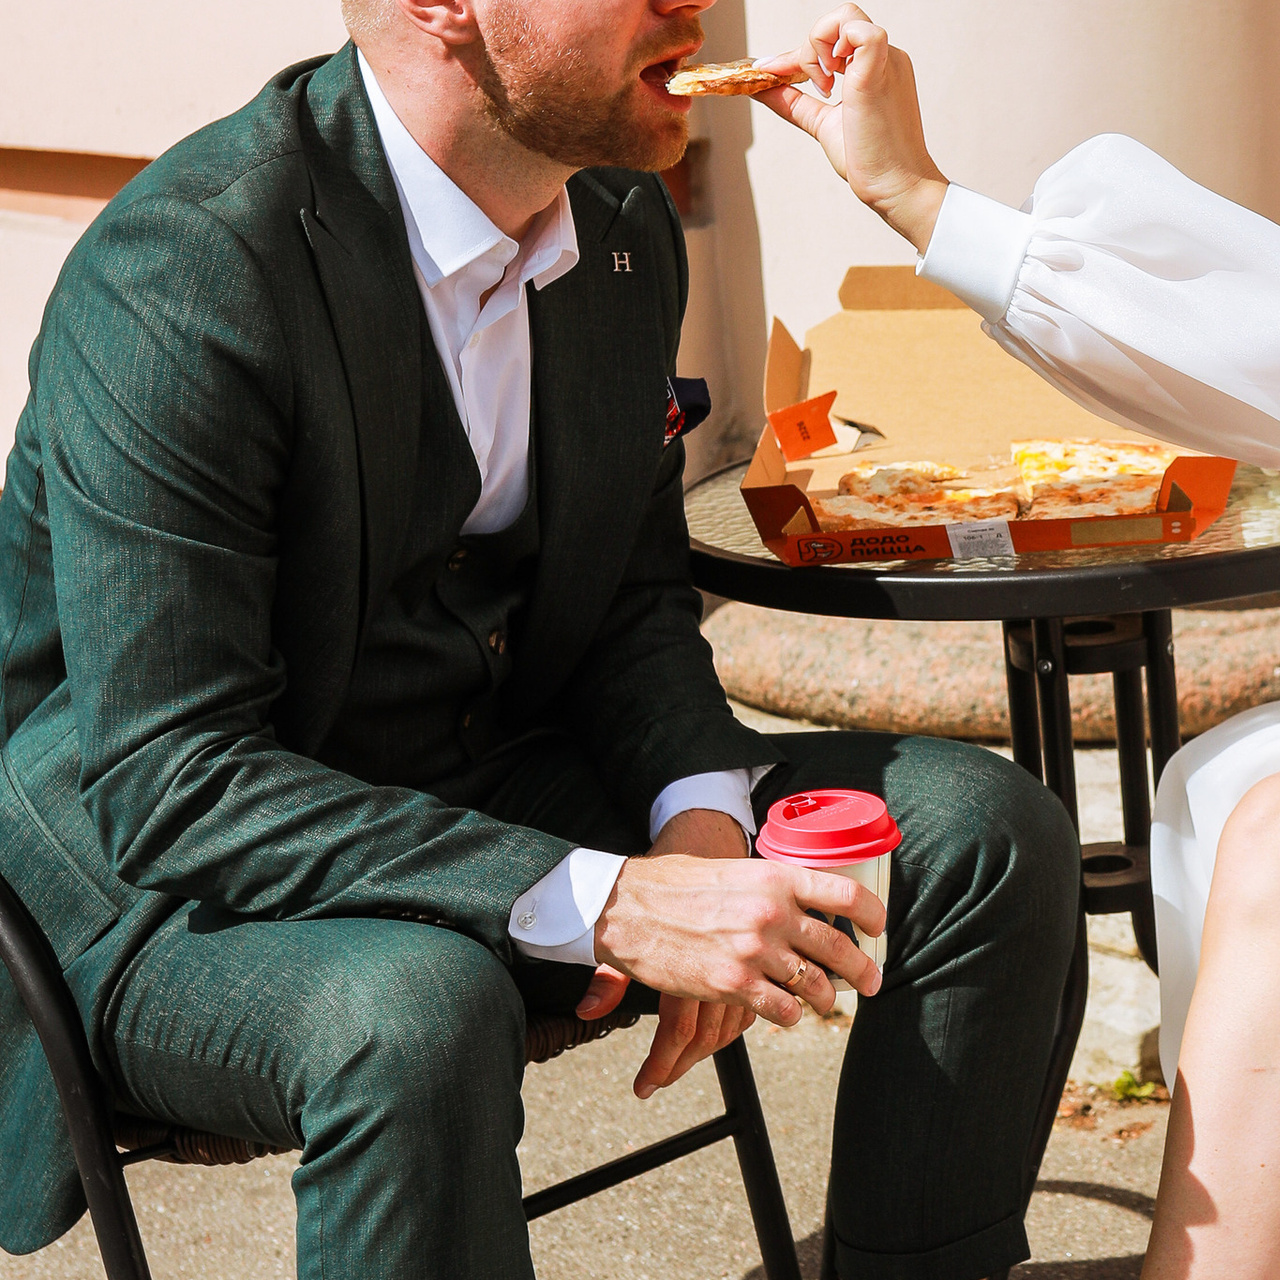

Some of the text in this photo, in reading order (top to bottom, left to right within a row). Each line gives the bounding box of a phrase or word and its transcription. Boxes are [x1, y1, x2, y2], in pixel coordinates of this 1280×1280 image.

[611, 252, 632, 272] H
[851, 535, 909, 547] ДОДО
[851, 545, 925, 556] ПИЦЦА
